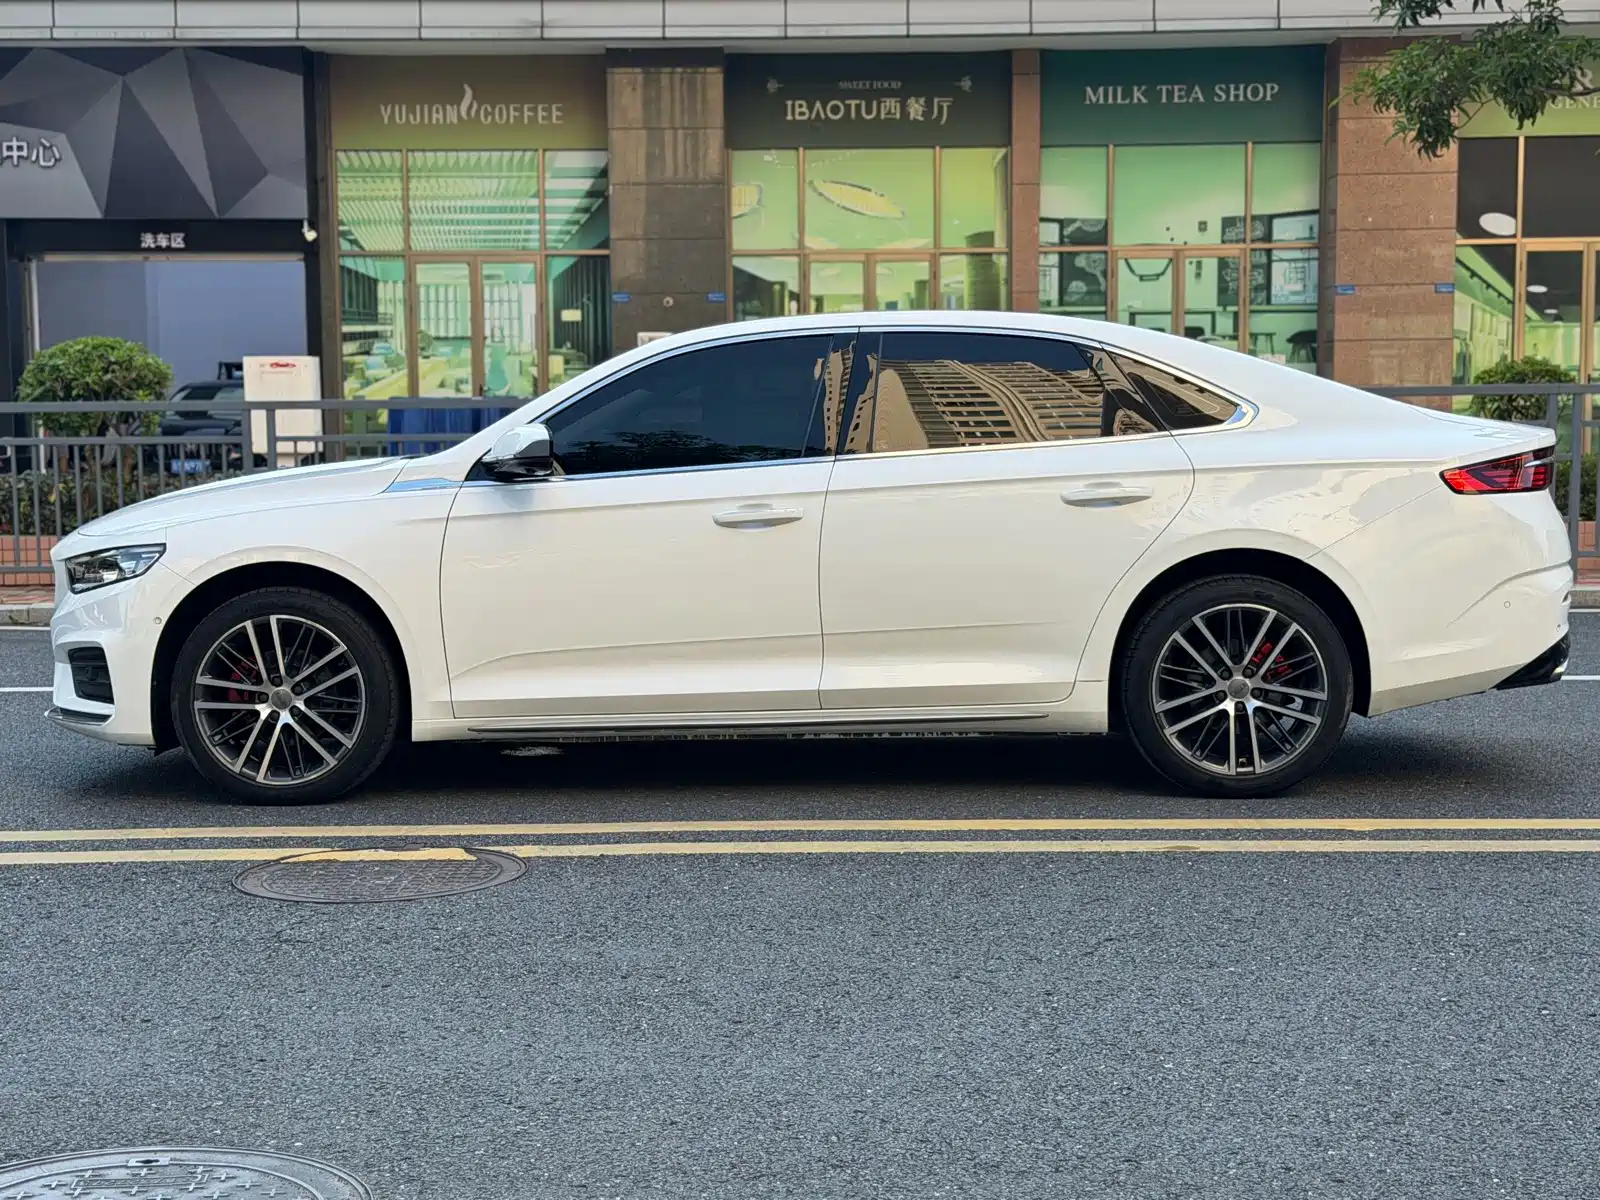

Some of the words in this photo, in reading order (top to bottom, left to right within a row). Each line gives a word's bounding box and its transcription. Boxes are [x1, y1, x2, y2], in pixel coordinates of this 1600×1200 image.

[1084, 85, 1149, 105] MILK
[1156, 84, 1205, 104] TEA
[1213, 83, 1279, 103] SHOP
[380, 103, 458, 125] YUJIAN
[479, 103, 565, 125] COFFEE
[2, 136, 61, 167] 中心
[140, 232, 186, 248] 洗车区
